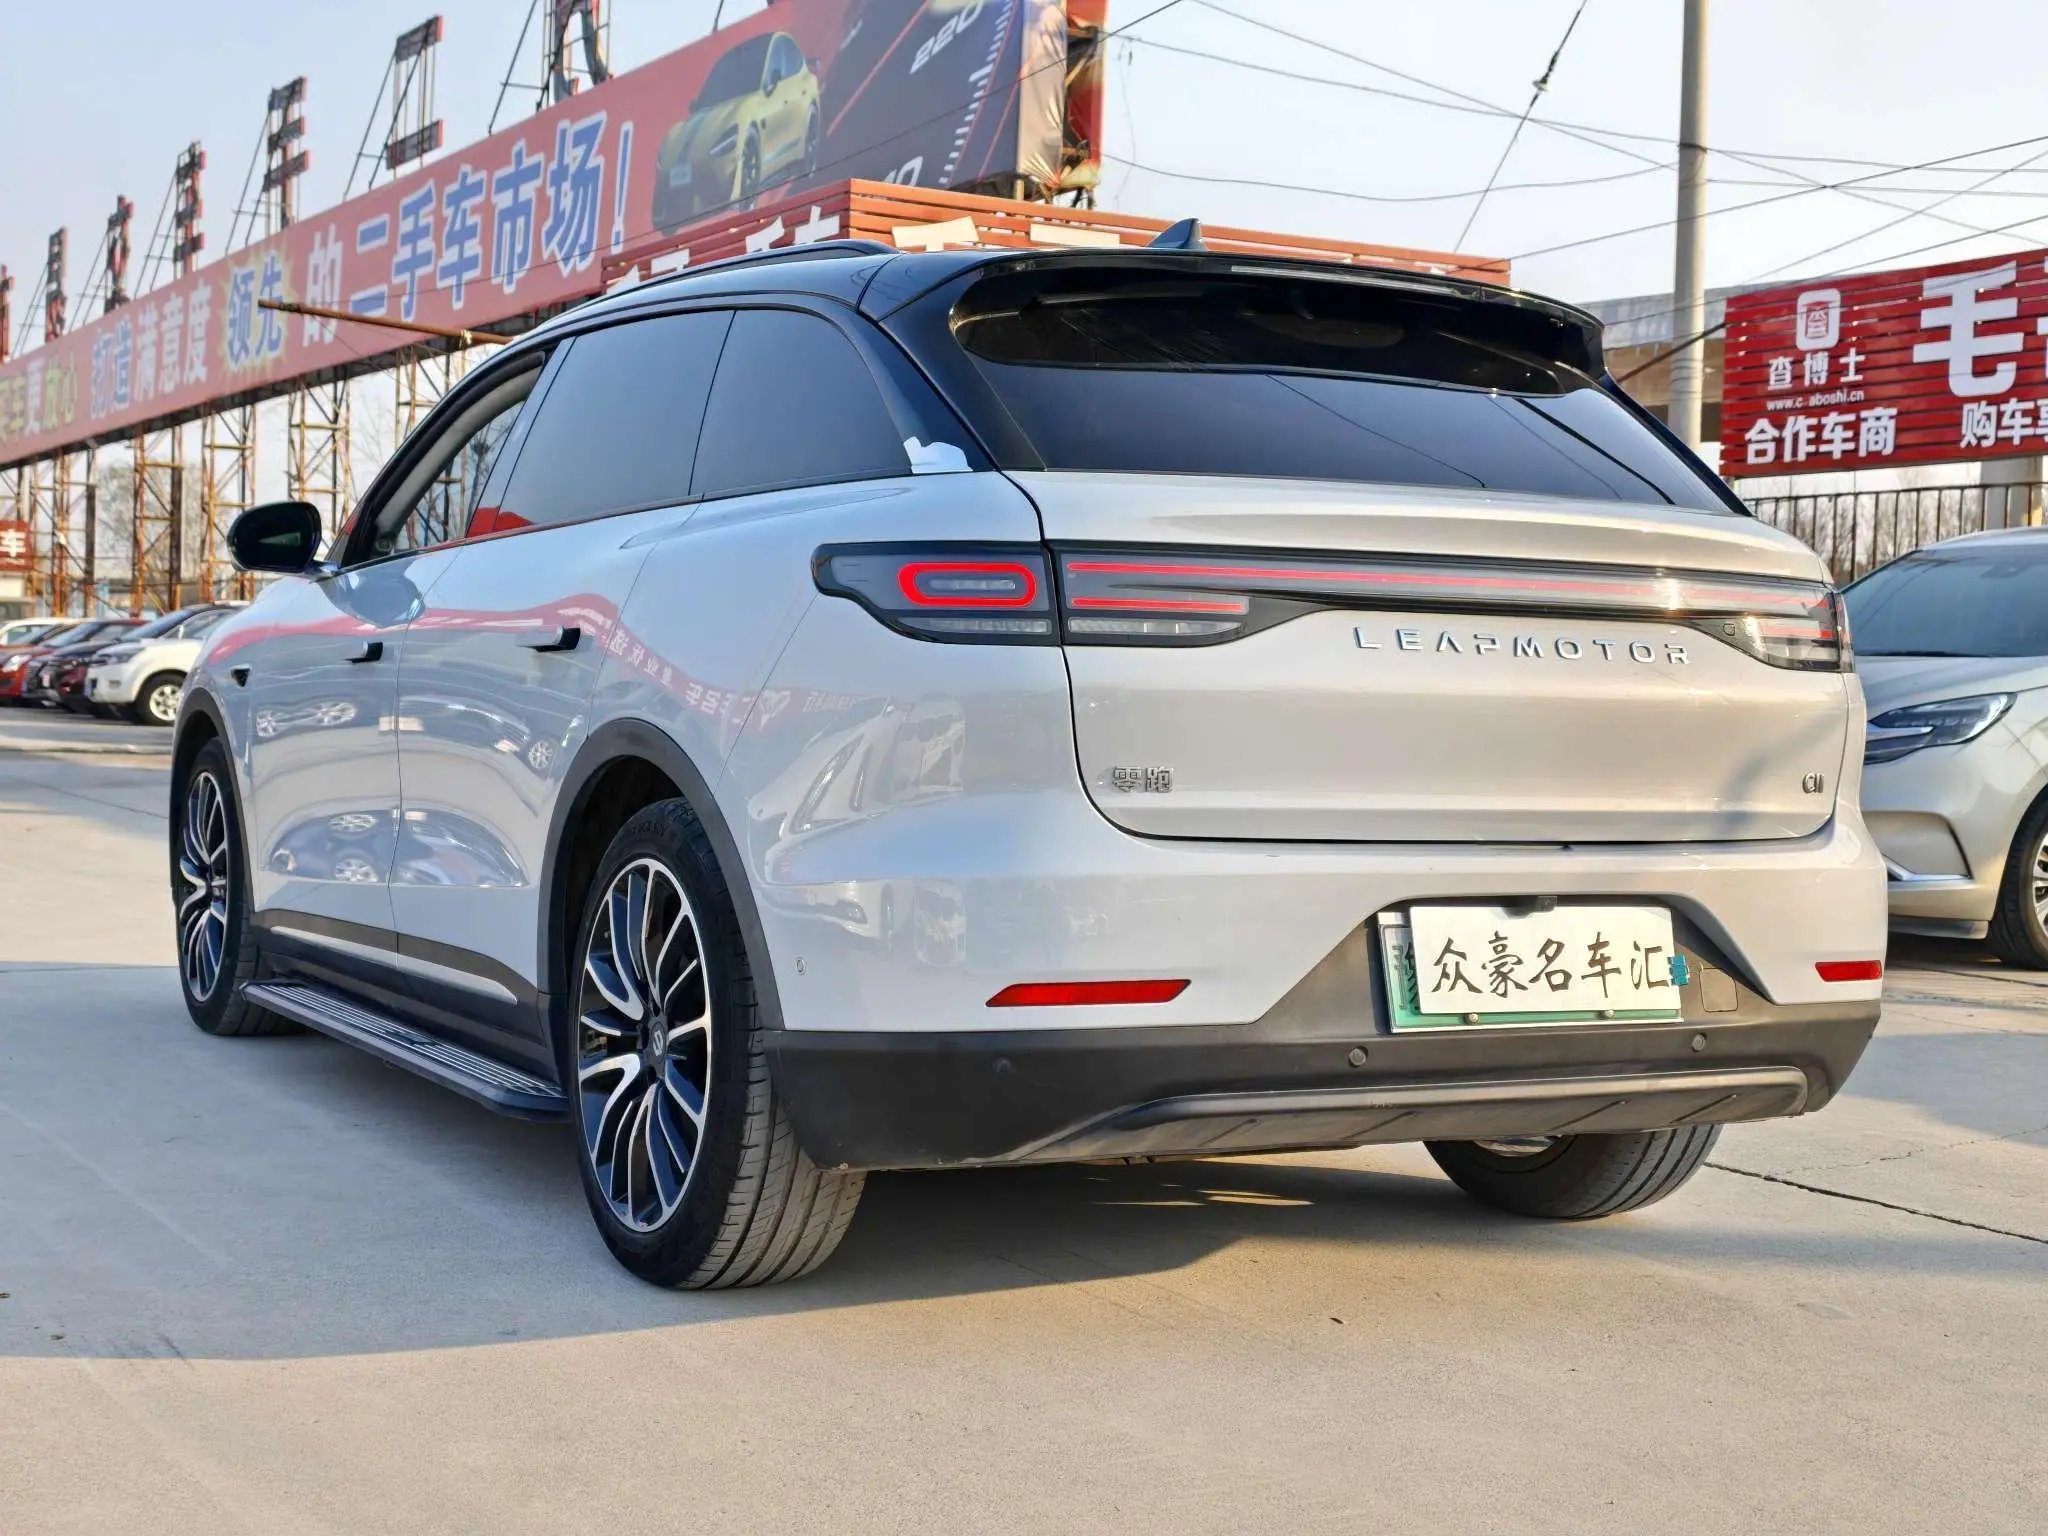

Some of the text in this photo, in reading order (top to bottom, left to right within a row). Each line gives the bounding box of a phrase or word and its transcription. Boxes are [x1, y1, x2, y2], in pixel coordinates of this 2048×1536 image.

[1913, 255, 2048, 398] 毛
[1767, 347, 1867, 391] 查博士
[1744, 406, 1898, 465] 合作车商
[1353, 626, 1691, 666] LEAPMOTOR
[1112, 766, 1175, 794] 零跑
[1431, 930, 1670, 999] 众豪名车汇
